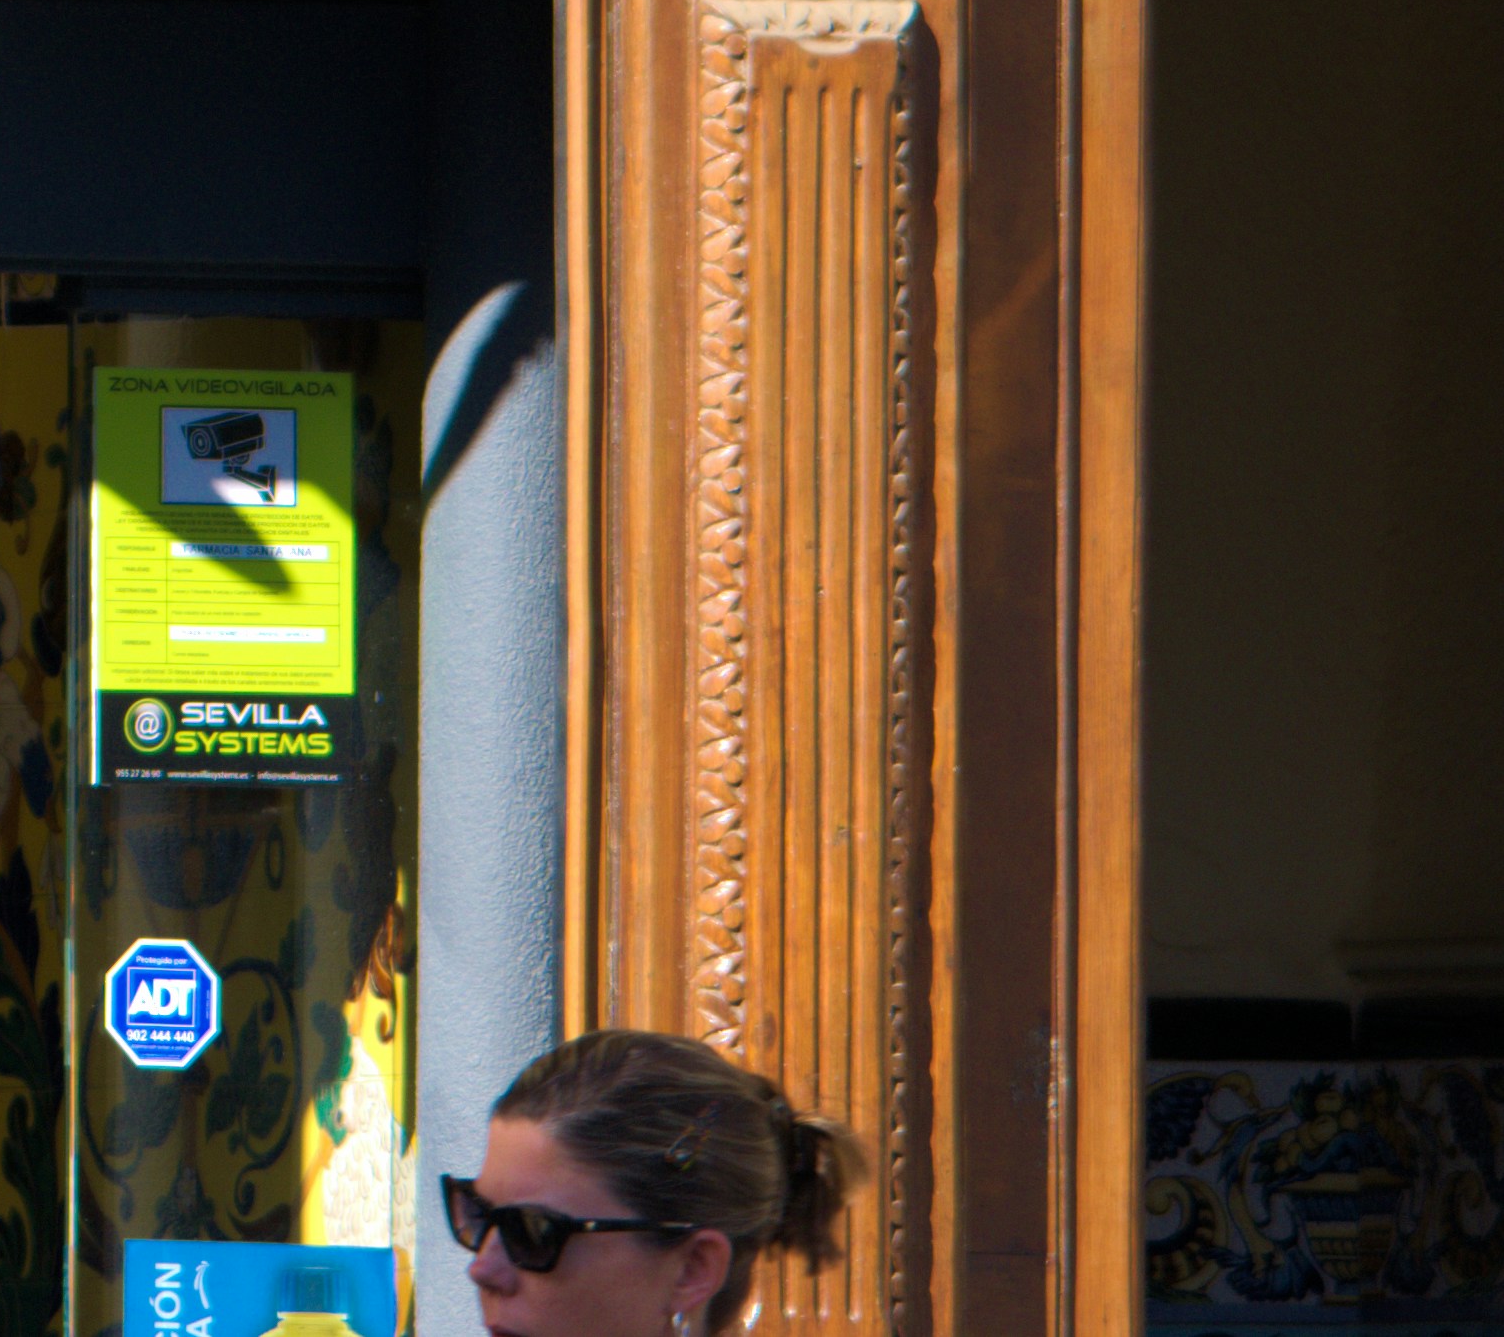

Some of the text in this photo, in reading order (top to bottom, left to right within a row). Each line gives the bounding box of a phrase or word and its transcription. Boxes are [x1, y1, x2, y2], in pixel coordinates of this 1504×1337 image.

[109, 377, 336, 397] ZONA VIDEOVIGILADA
[183, 543, 312, 558] FARMACIA SANTA ANA
[181, 701, 325, 726] SEVILLA
[174, 731, 332, 755] SYSTEMS
[135, 955, 172, 965] Protegido
[127, 978, 197, 1017] ADT
[126, 1028, 147, 1042] 902
[149, 1262, 181, 1337] IÓN
